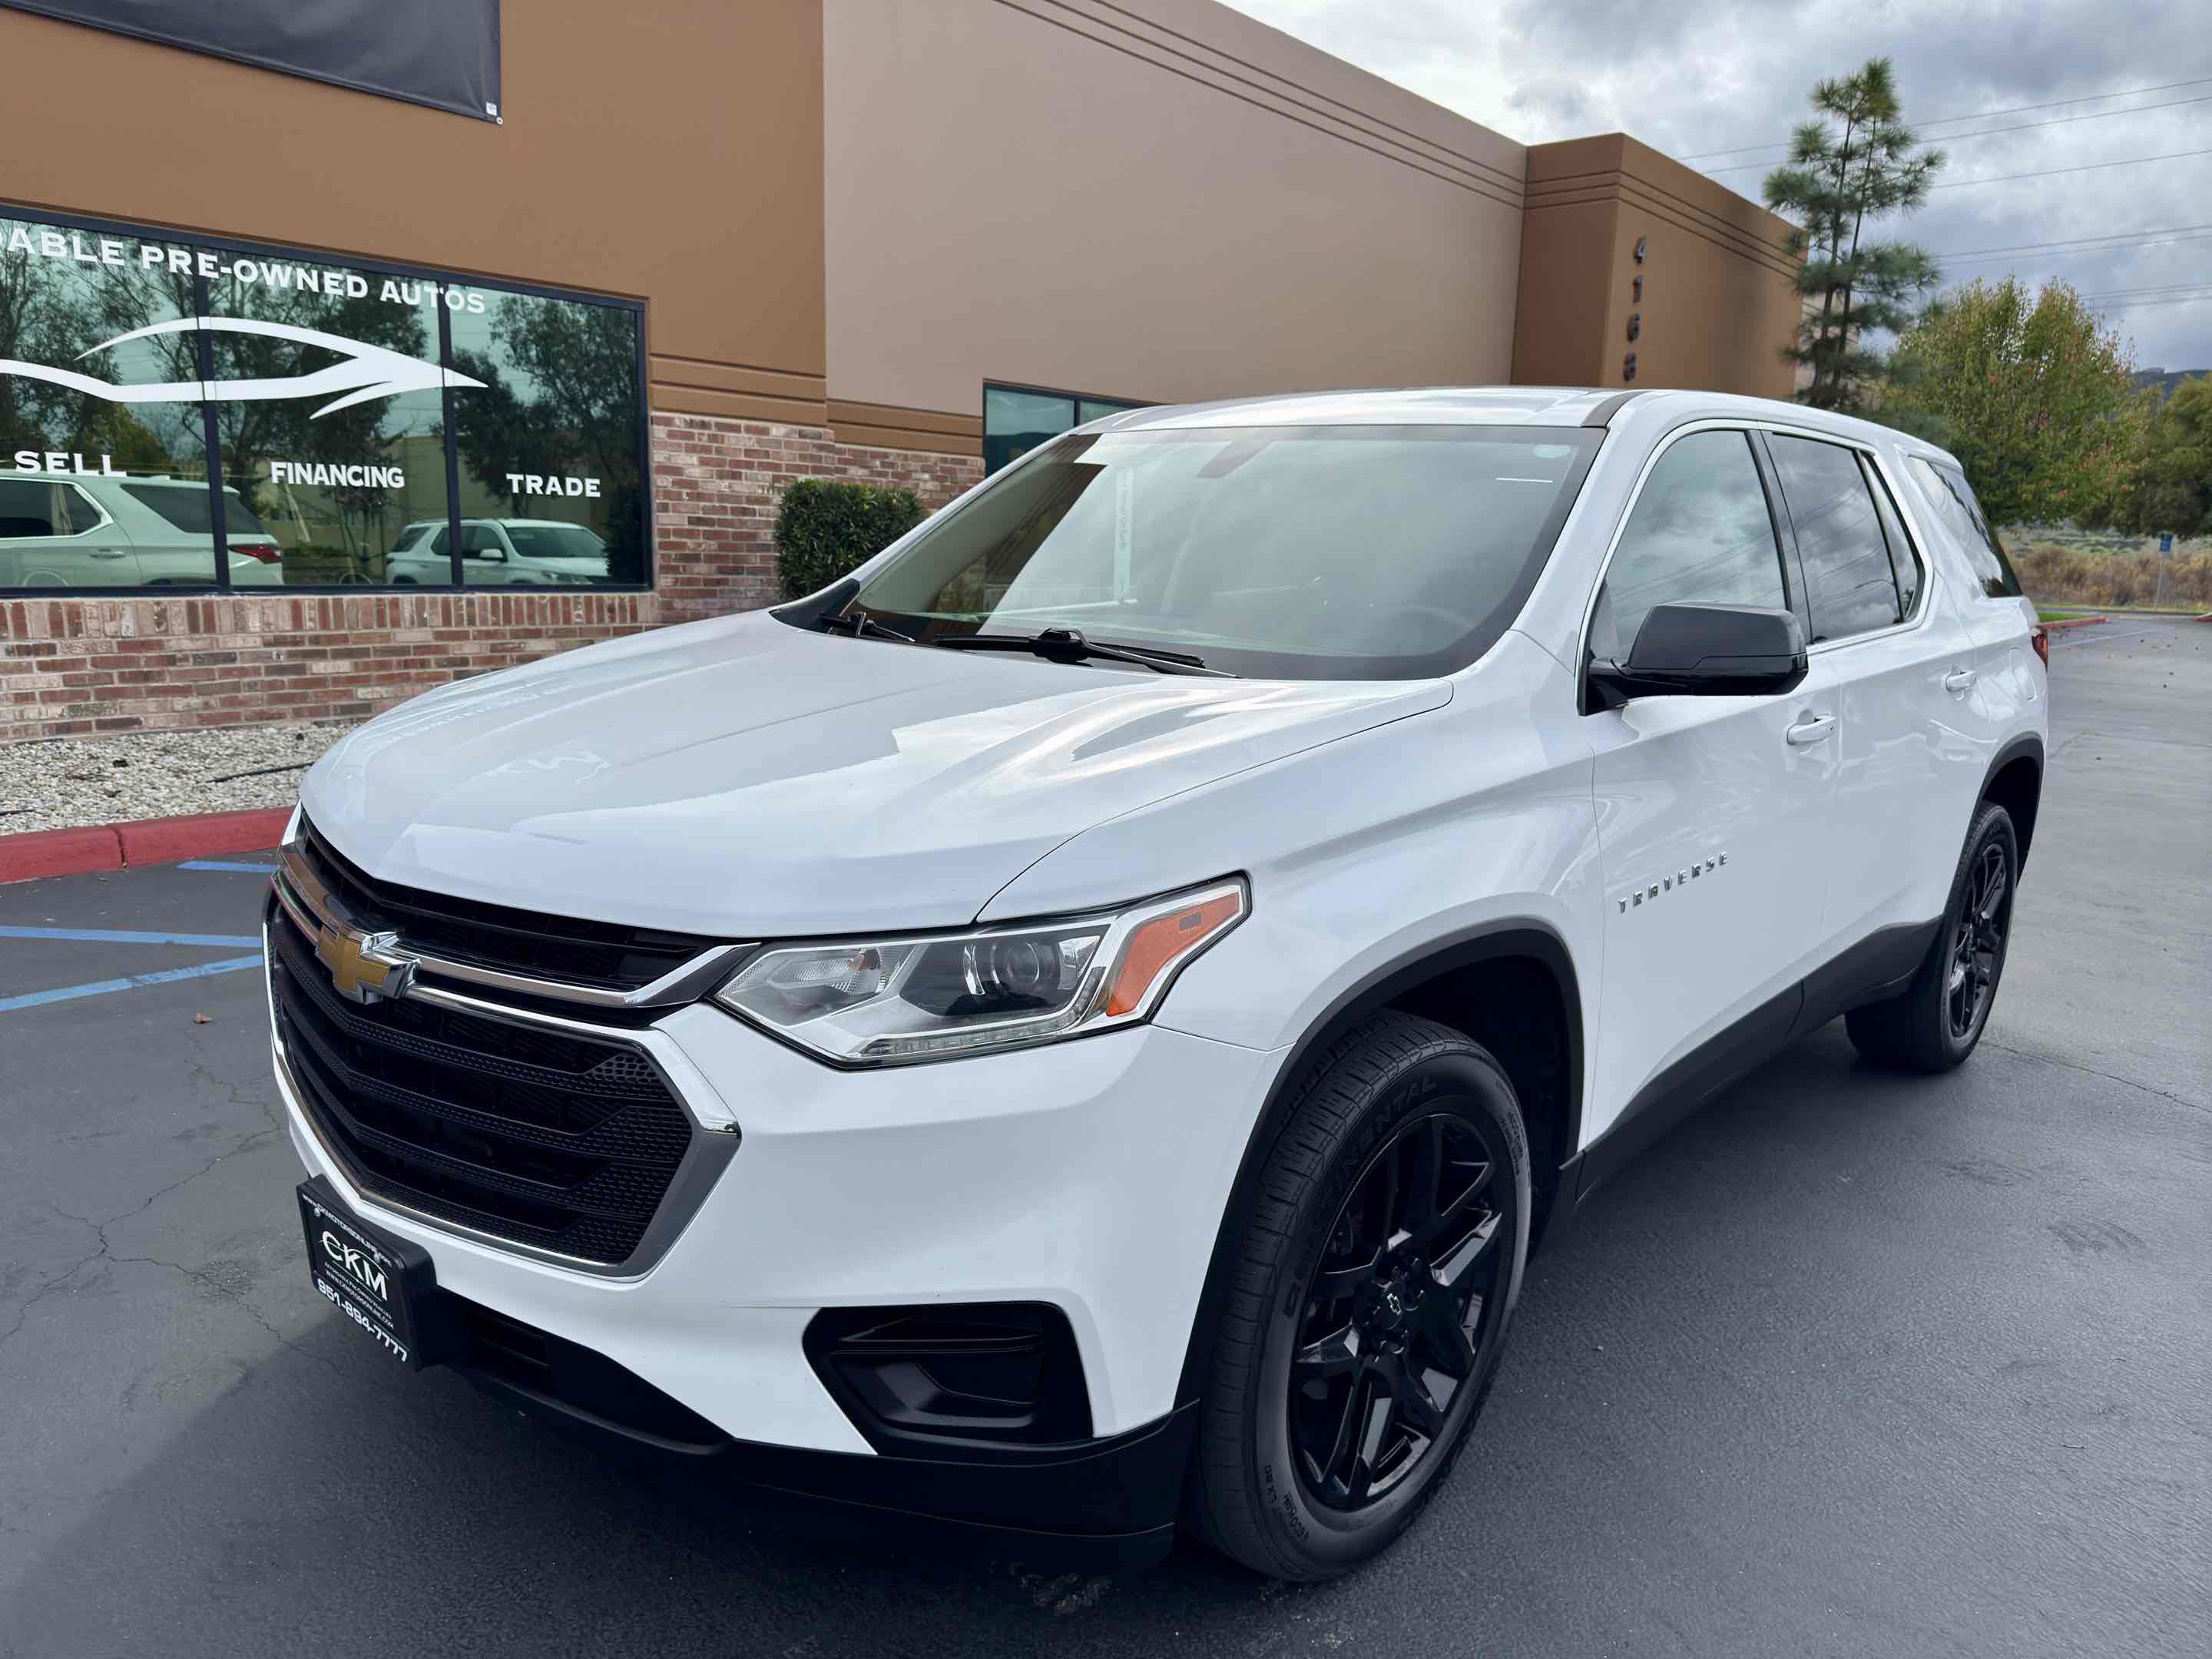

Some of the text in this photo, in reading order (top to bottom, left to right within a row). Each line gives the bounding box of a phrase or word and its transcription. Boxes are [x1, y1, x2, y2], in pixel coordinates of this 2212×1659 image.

[0, 227, 485, 313] ABLE PRE-OWNED AUTOS
[14, 450, 127, 478] SELL
[270, 462, 406, 488] FINANCING
[505, 473, 601, 498] TRADE
[1617, 851, 1727, 914] TRAVERSE
[321, 1230, 388, 1301] CKM
